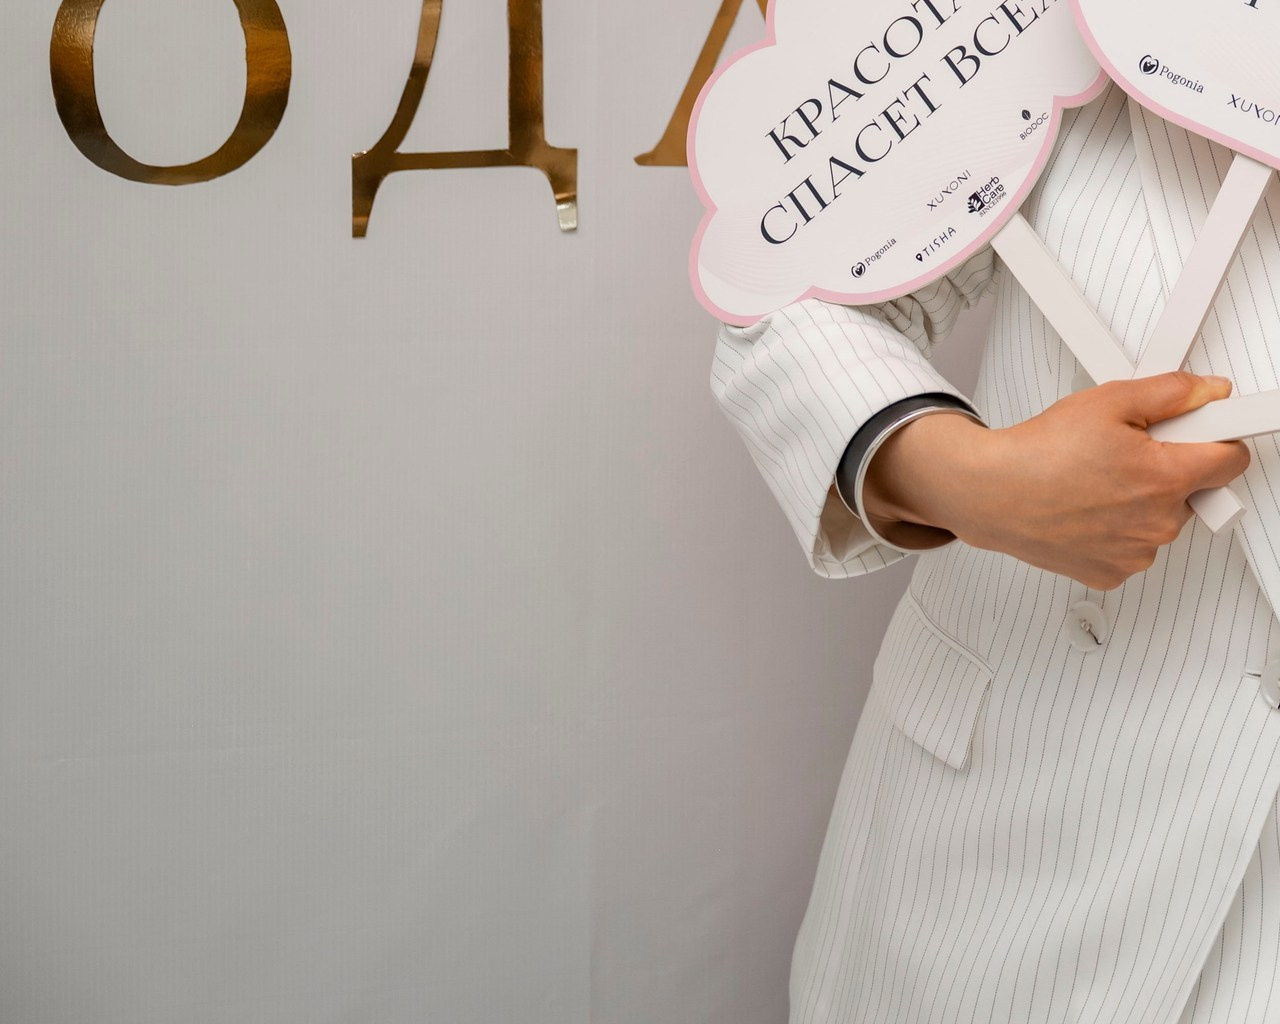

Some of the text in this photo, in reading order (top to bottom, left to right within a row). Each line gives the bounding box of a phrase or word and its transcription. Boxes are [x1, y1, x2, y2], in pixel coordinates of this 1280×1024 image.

[1159, 66, 1204, 94] Pogonia
[1019, 112, 1049, 140] BIODOC
[760, 72, 942, 244] СПАСЕТ
[976, 176, 1000, 196] Herb
[982, 183, 1005, 205] Care
[864, 237, 897, 266] Pogonia
[923, 226, 957, 257] TISHA
